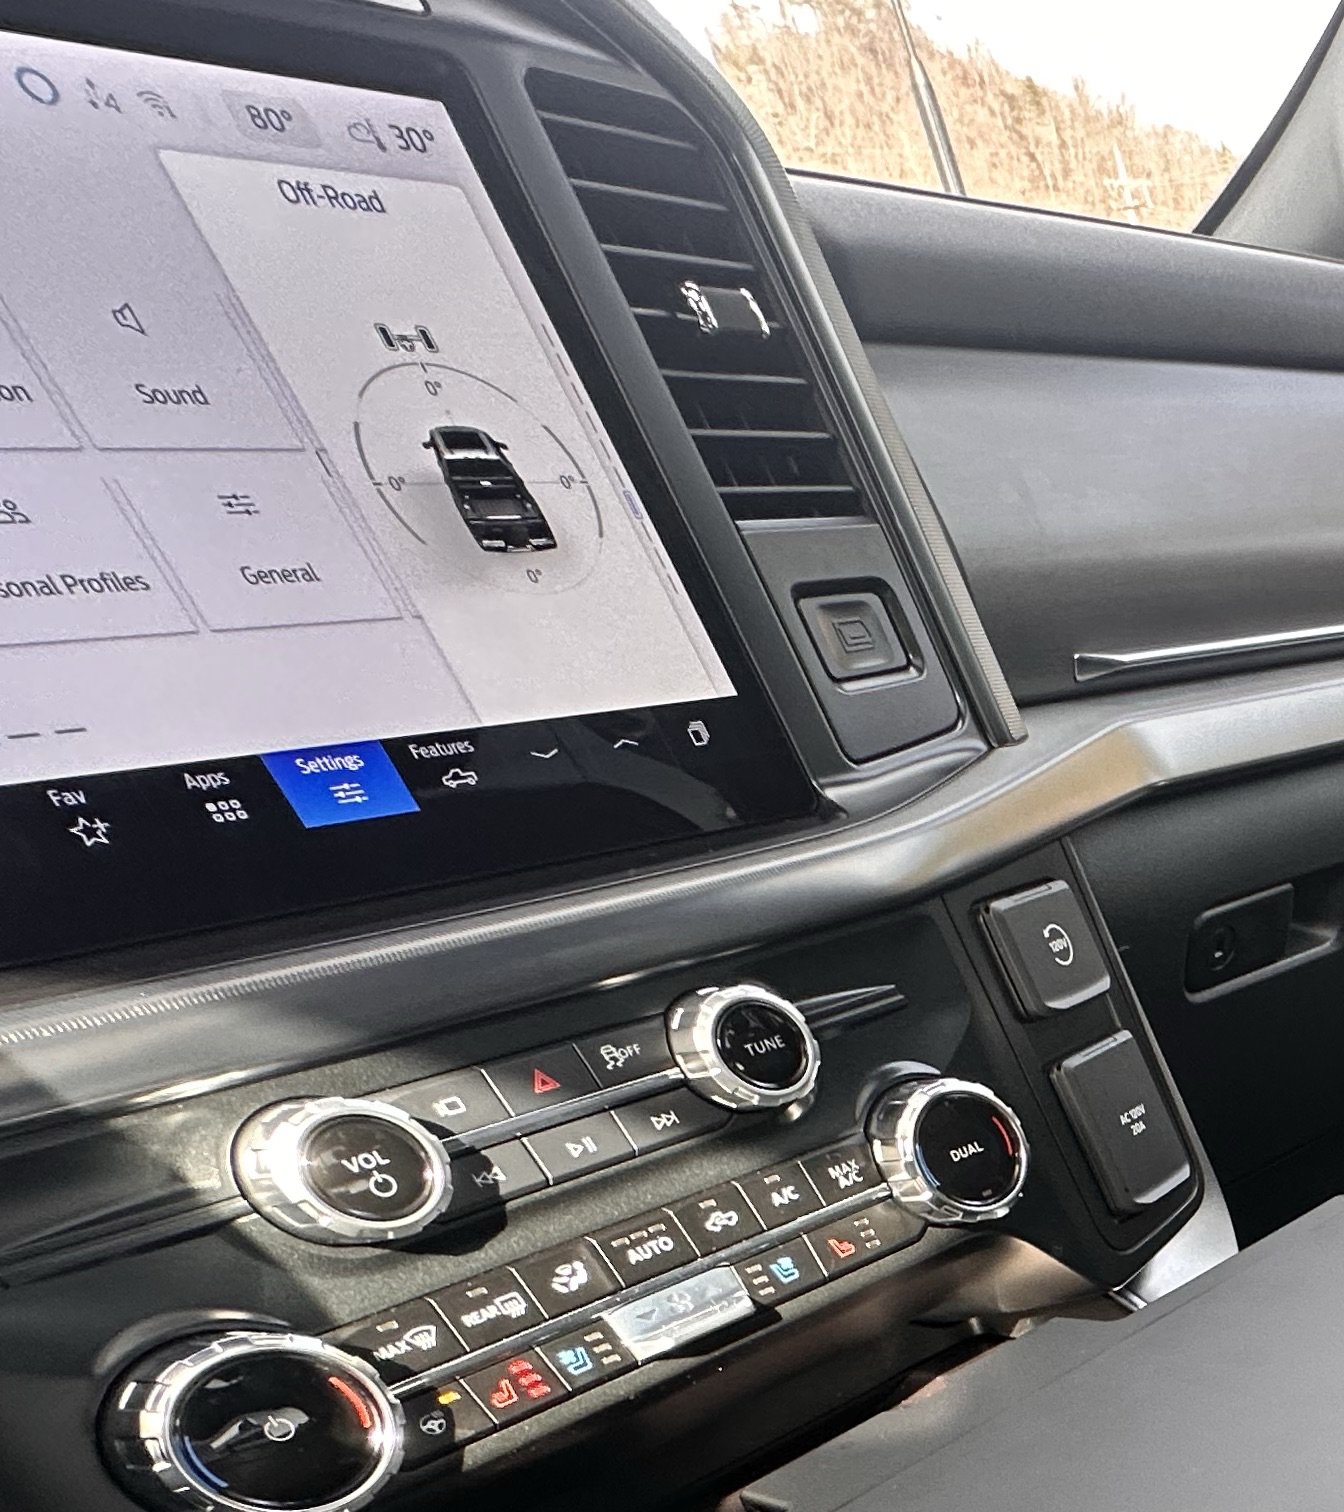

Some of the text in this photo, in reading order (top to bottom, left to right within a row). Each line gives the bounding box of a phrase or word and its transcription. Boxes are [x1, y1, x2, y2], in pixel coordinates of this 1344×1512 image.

[246, 104, 293, 133] 80°
[388, 124, 435, 154] 30°
[277, 178, 387, 214] Off-Road
[134, 383, 211, 406] Sound
[424, 379, 442, 396] 0°
[388, 475, 406, 492] 0°
[559, 474, 575, 490] 0°
[0, 571, 151, 598] sonal Profiles
[239, 563, 322, 586] General
[526, 567, 543, 584] 0°
[409, 738, 476, 760] Features
[294, 752, 365, 775] Settings
[183, 770, 230, 791] Apps
[47, 789, 87, 808] Fav
[1048, 937, 1068, 954] 120V
[619, 1043, 641, 1060] OFF
[744, 1034, 787, 1057] TUNE
[1119, 1102, 1146, 1126] AC 120V
[1130, 1119, 1147, 1136] 20A
[340, 1150, 391, 1173] VOL
[949, 1141, 985, 1164] DUAL
[828, 1159, 860, 1180] MAX
[838, 1170, 864, 1190] A/C
[770, 1185, 800, 1208] A/C
[626, 1236, 675, 1265] AUTO
[460, 1304, 501, 1328] REAR
[373, 1339, 414, 1362] MAX
